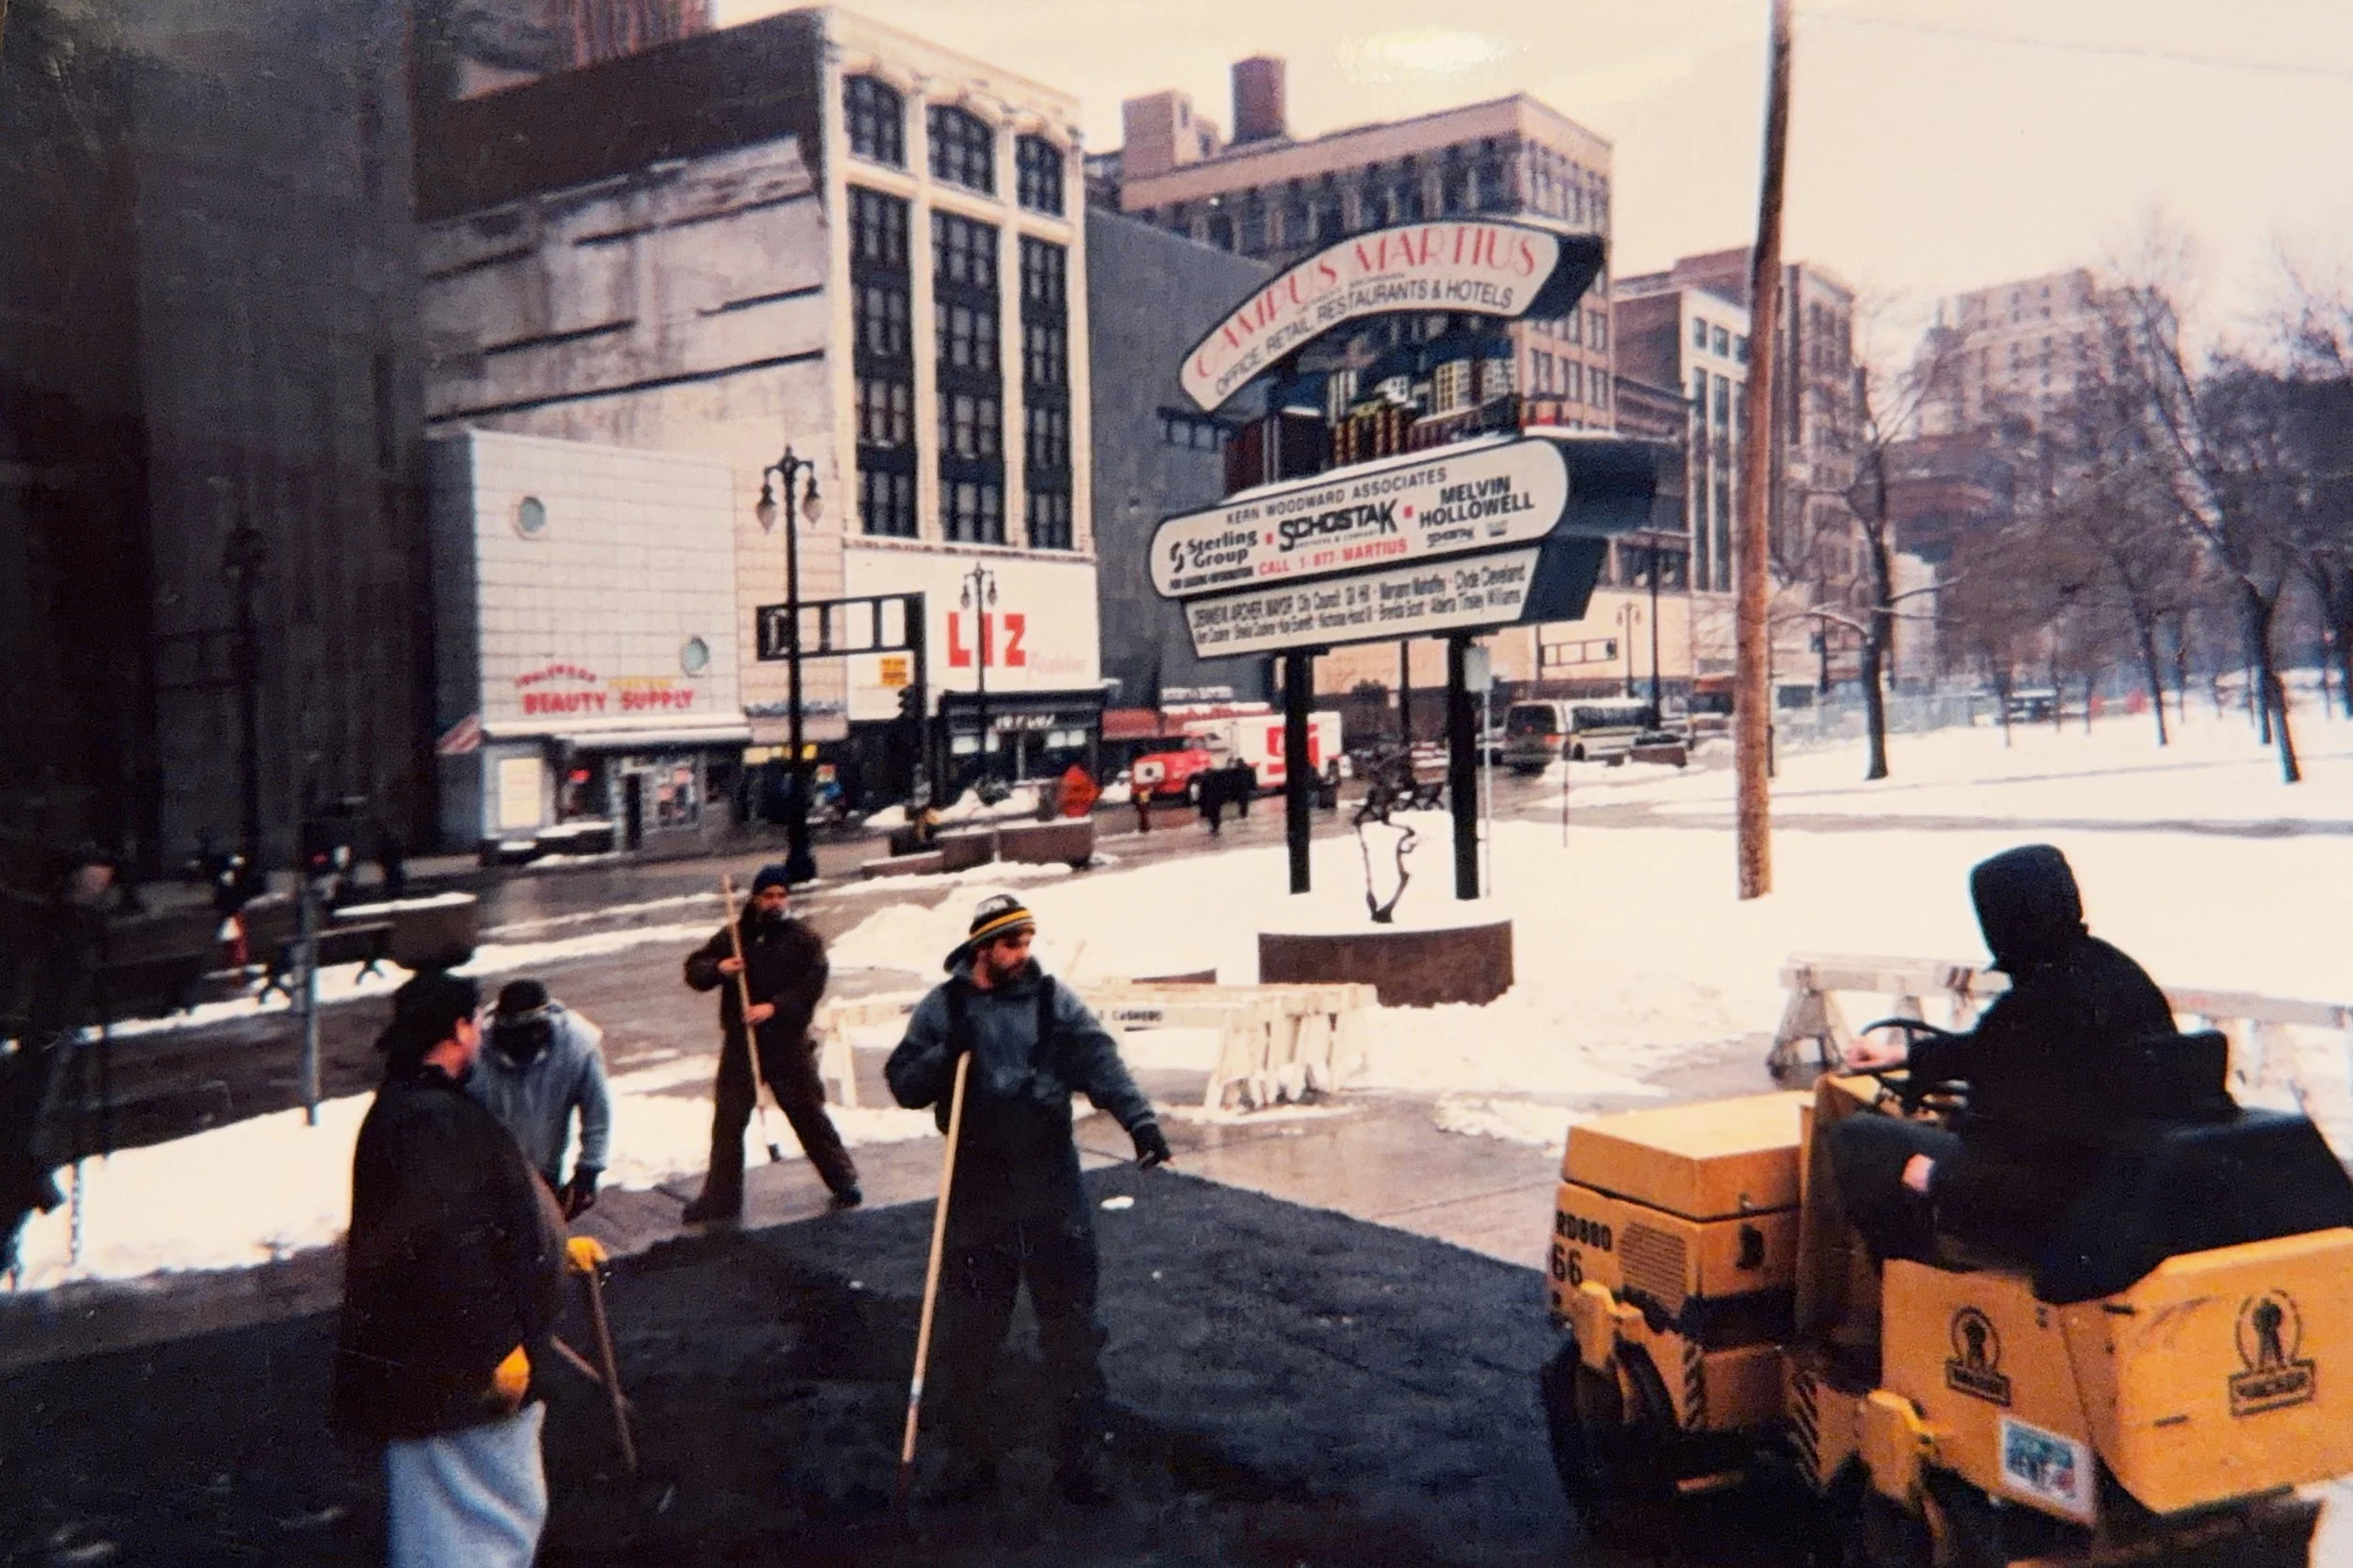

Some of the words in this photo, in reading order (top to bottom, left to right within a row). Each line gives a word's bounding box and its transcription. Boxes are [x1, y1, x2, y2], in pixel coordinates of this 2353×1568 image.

[1196, 258, 1337, 378] CAMPUS
[1353, 226, 1535, 279] MARTIUS
[1317, 280, 1428, 323] RESTAURANTS
[1432, 280, 1441, 299] &
[1446, 280, 1513, 310] HOTELS
[1226, 506, 1259, 525] KERN
[1266, 489, 1345, 517] WOODWARD
[1353, 467, 1448, 500] ASSOCIATES
[1440, 474, 1512, 505] MELVIN
[1279, 498, 1399, 552] SCHOSTAK
[1419, 491, 1534, 529] HOLLOWELL
[1187, 530, 1257, 555] Sterling
[1193, 548, 1249, 568] Group
[1258, 561, 1290, 576] CALL
[948, 611, 1026, 667] LIZ
[523, 692, 607, 714] BEAUTY
[621, 689, 694, 710] SUPPLY
[1551, 1243, 1583, 1288] 66
